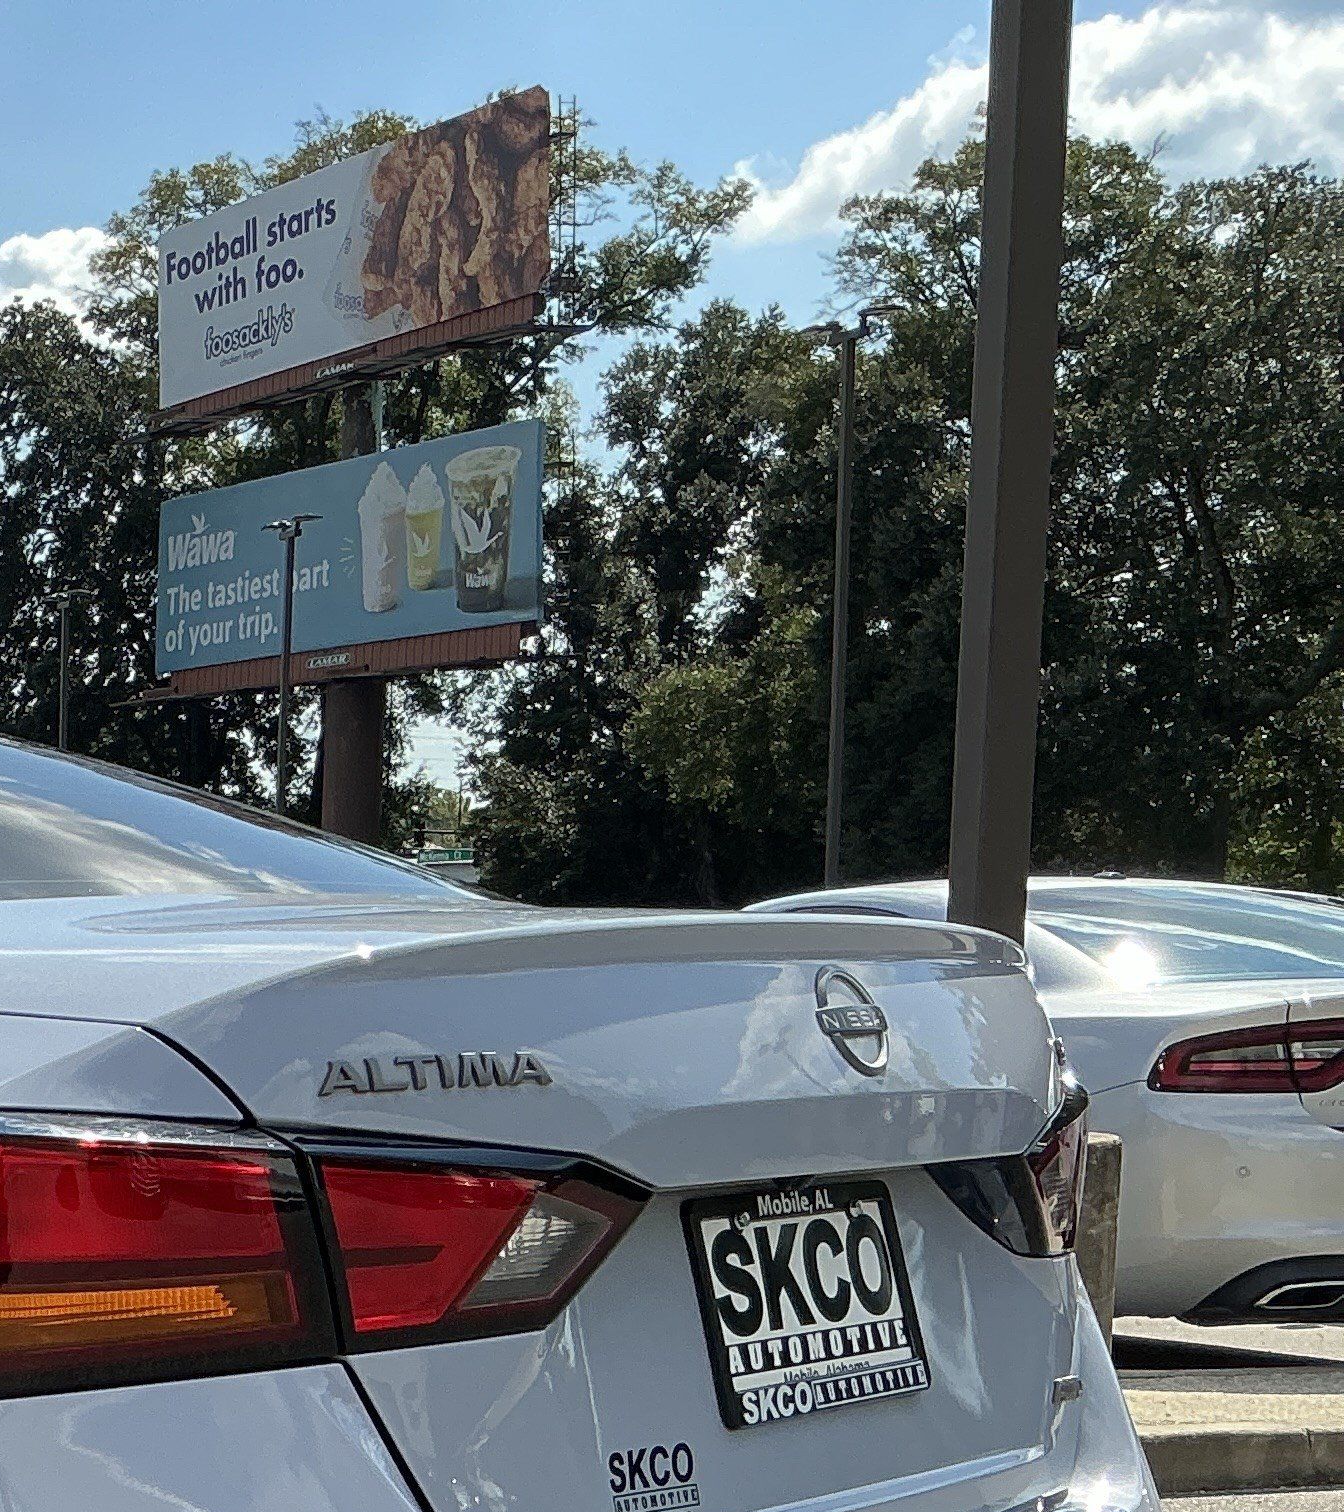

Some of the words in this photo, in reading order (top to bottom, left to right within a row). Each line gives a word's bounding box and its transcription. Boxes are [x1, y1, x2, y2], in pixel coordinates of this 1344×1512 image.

[166, 216, 257, 285] Football
[266, 198, 336, 247] starts
[194, 266, 247, 314] with
[255, 255, 304, 294] foo.
[204, 303, 293, 360] foosackly's
[167, 530, 235, 572] Wawa
[167, 584, 202, 616] The
[207, 568, 280, 609] tastiest
[165, 619, 186, 653] of
[189, 619, 234, 656] your
[238, 605, 278, 644] trip.
[309, 654, 347, 668] LAMAR
[317, 1051, 554, 1097] ALTIMA
[758, 1190, 813, 1217] Mobile,
[815, 1189, 835, 1210] AL
[712, 1213, 893, 1337] SKCO
[729, 1319, 908, 1375] AUTOMOTIVE
[742, 1381, 813, 1425] SKCO
[815, 1363, 927, 1404] AUTOMOTIVE
[608, 1442, 694, 1493] SKCO
[616, 1488, 698, 1512] AUTOMOTIVE
